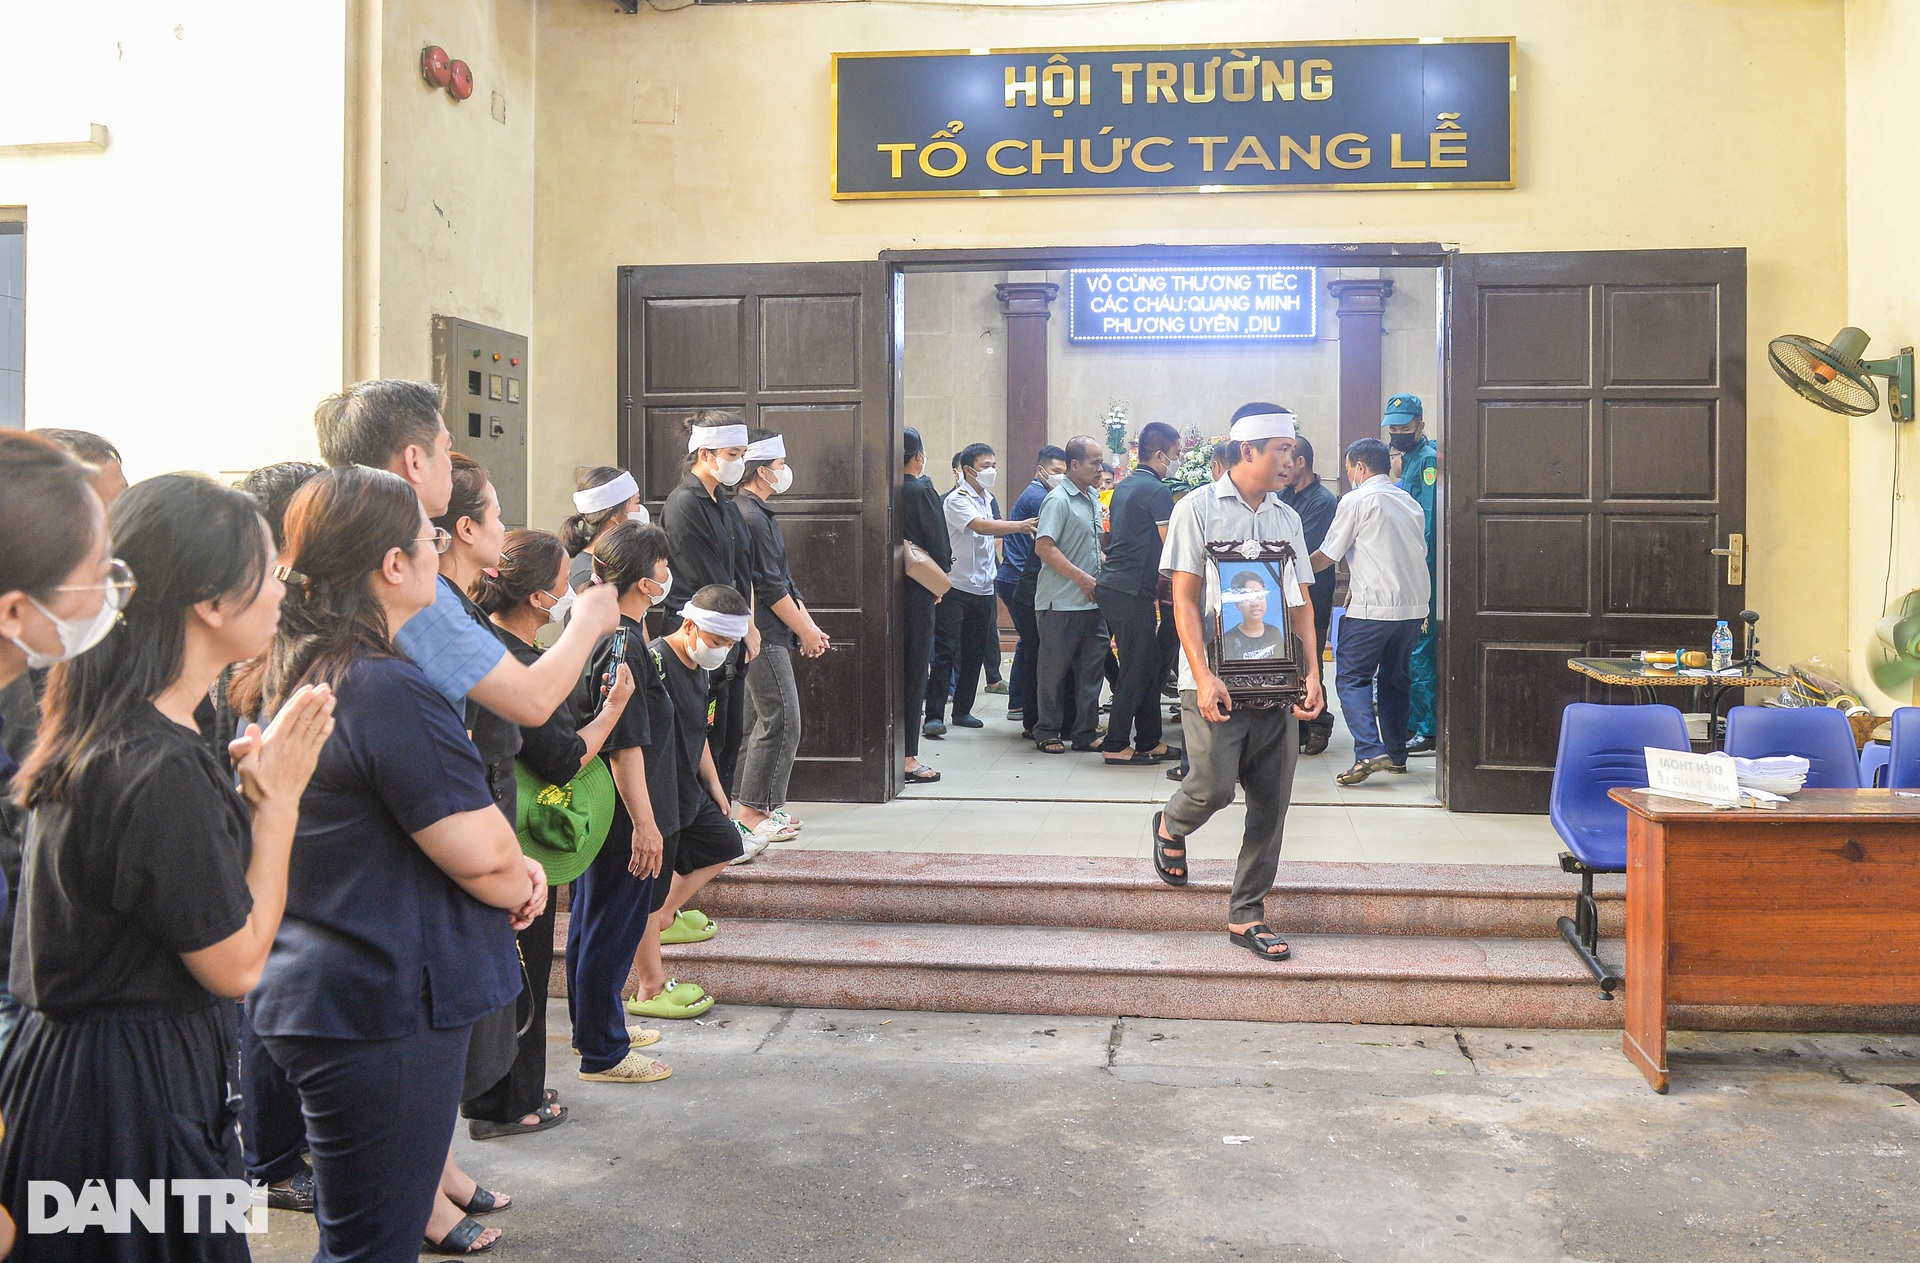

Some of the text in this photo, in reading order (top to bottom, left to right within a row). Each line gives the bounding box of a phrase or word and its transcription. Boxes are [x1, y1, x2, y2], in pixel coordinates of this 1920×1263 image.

[1004, 48, 1334, 118] HỘI TRƯỜNG
[877, 112, 1468, 179] TỔ CHỨC TANG LỄ
[1086, 271, 1297, 293] VÔ CÙNG THƯƠNG TIẾC
[1090, 294, 1129, 313] CÁC
[1255, 295, 1300, 311] MINH
[1103, 316, 1185, 333] PHƯƠNG
[1189, 313, 1238, 332] UYÊN
